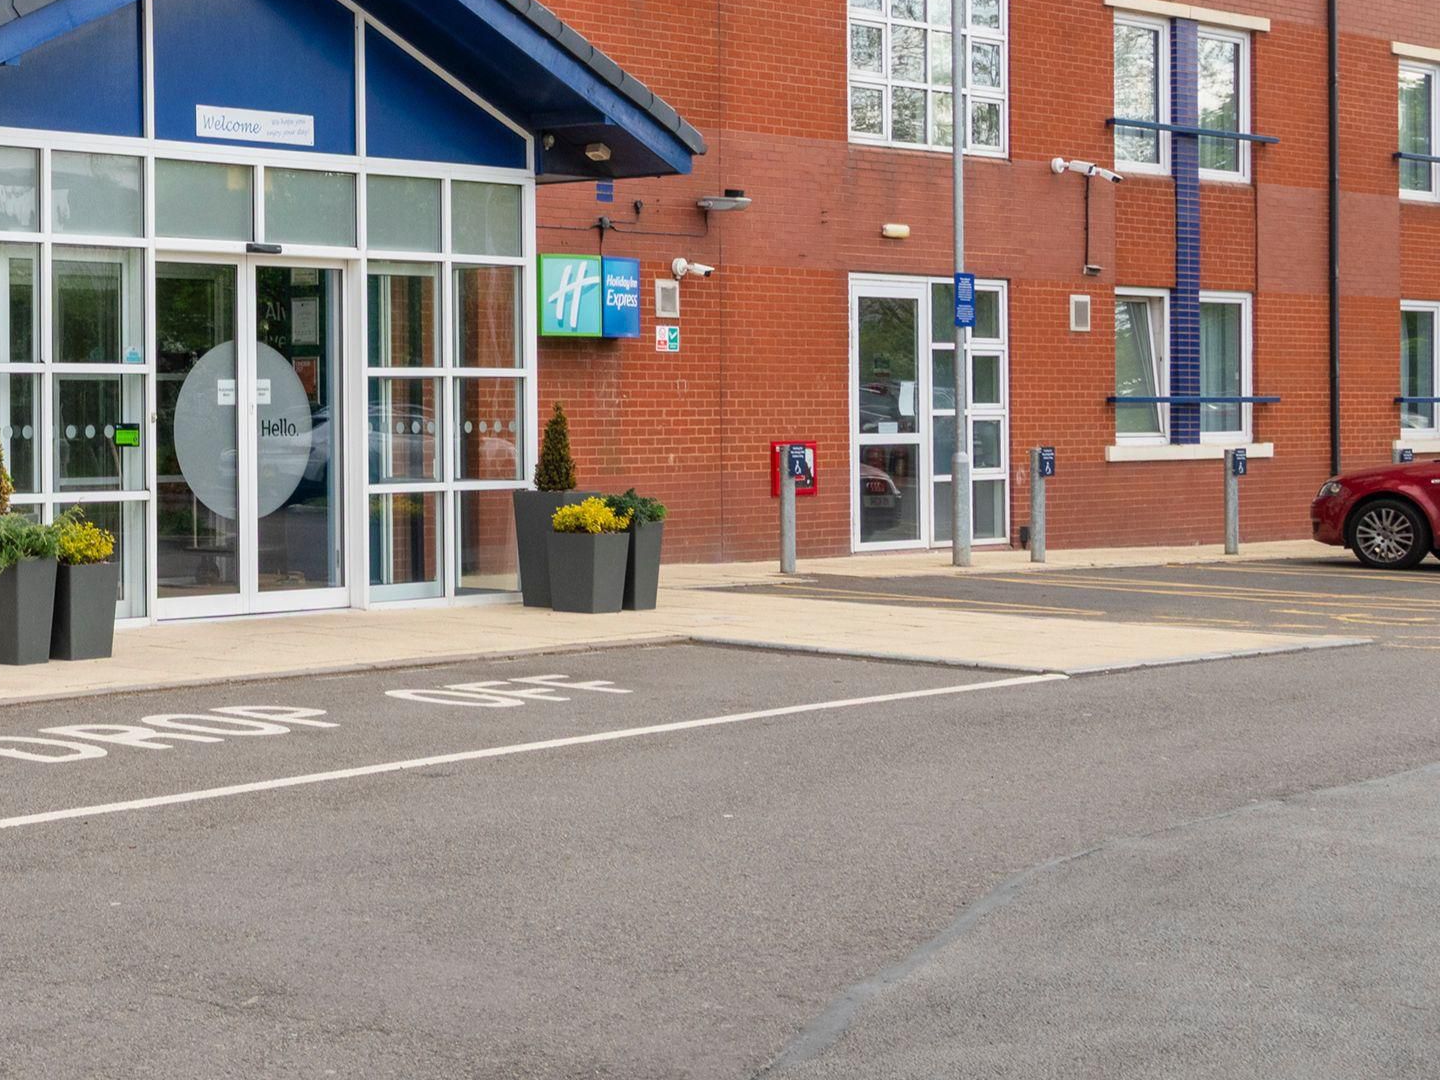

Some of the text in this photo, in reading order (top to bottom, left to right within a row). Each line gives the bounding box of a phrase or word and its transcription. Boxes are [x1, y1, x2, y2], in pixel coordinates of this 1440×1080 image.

[202, 113, 263, 135] Welcome
[606, 274, 630, 290] Holiday
[606, 289, 638, 310] Express
[261, 418, 299, 437] Hello.
[384, 674, 634, 708] OFF
